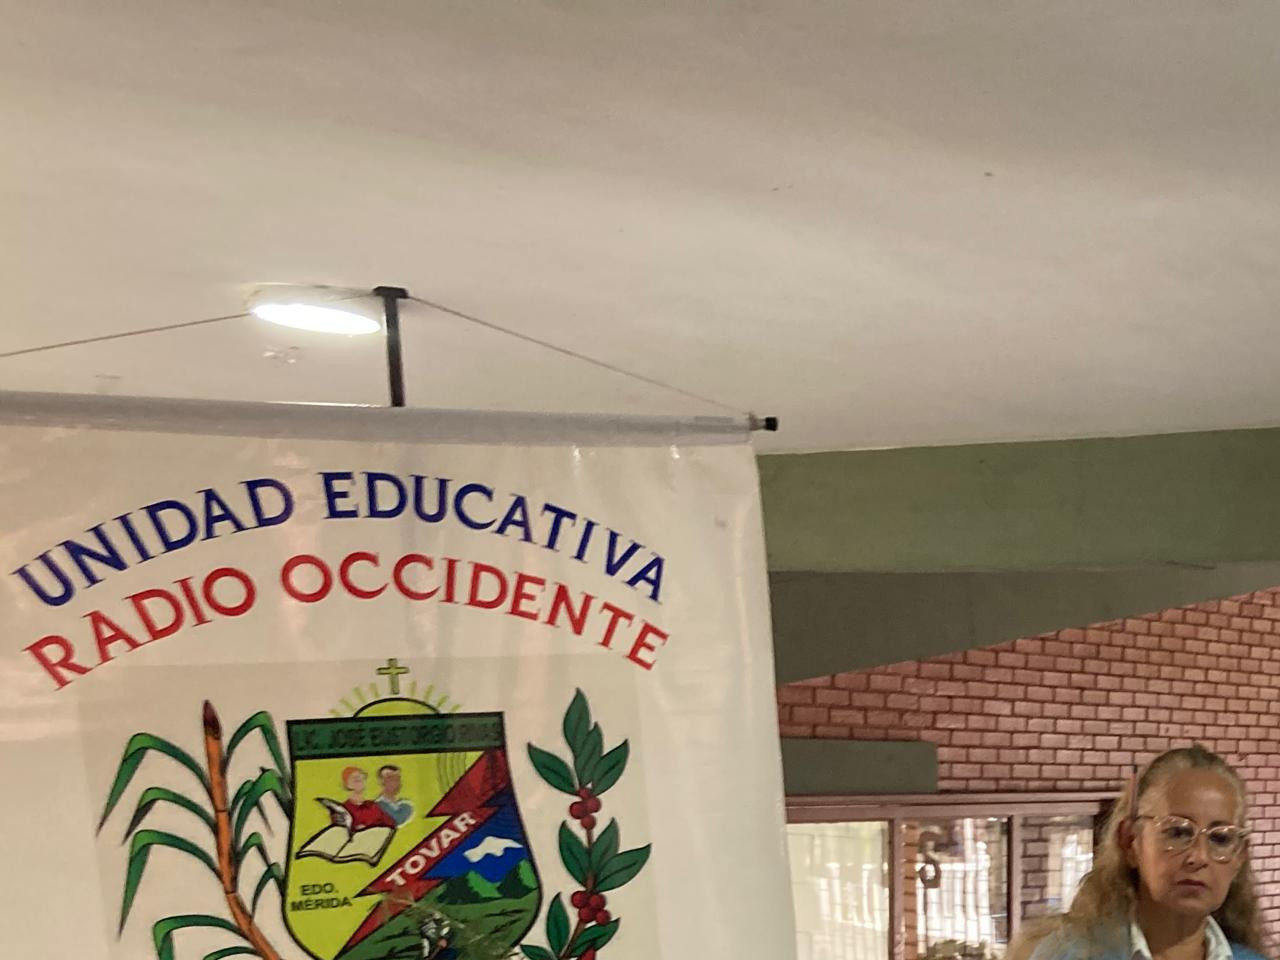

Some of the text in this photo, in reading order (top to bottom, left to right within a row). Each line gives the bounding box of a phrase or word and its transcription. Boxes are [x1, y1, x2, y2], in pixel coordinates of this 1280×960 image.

[12, 470, 670, 608] UNIDAD EDUCATIVA
[22, 551, 671, 692] RADIO OCCIDENTE
[384, 811, 478, 887] TOVAR
